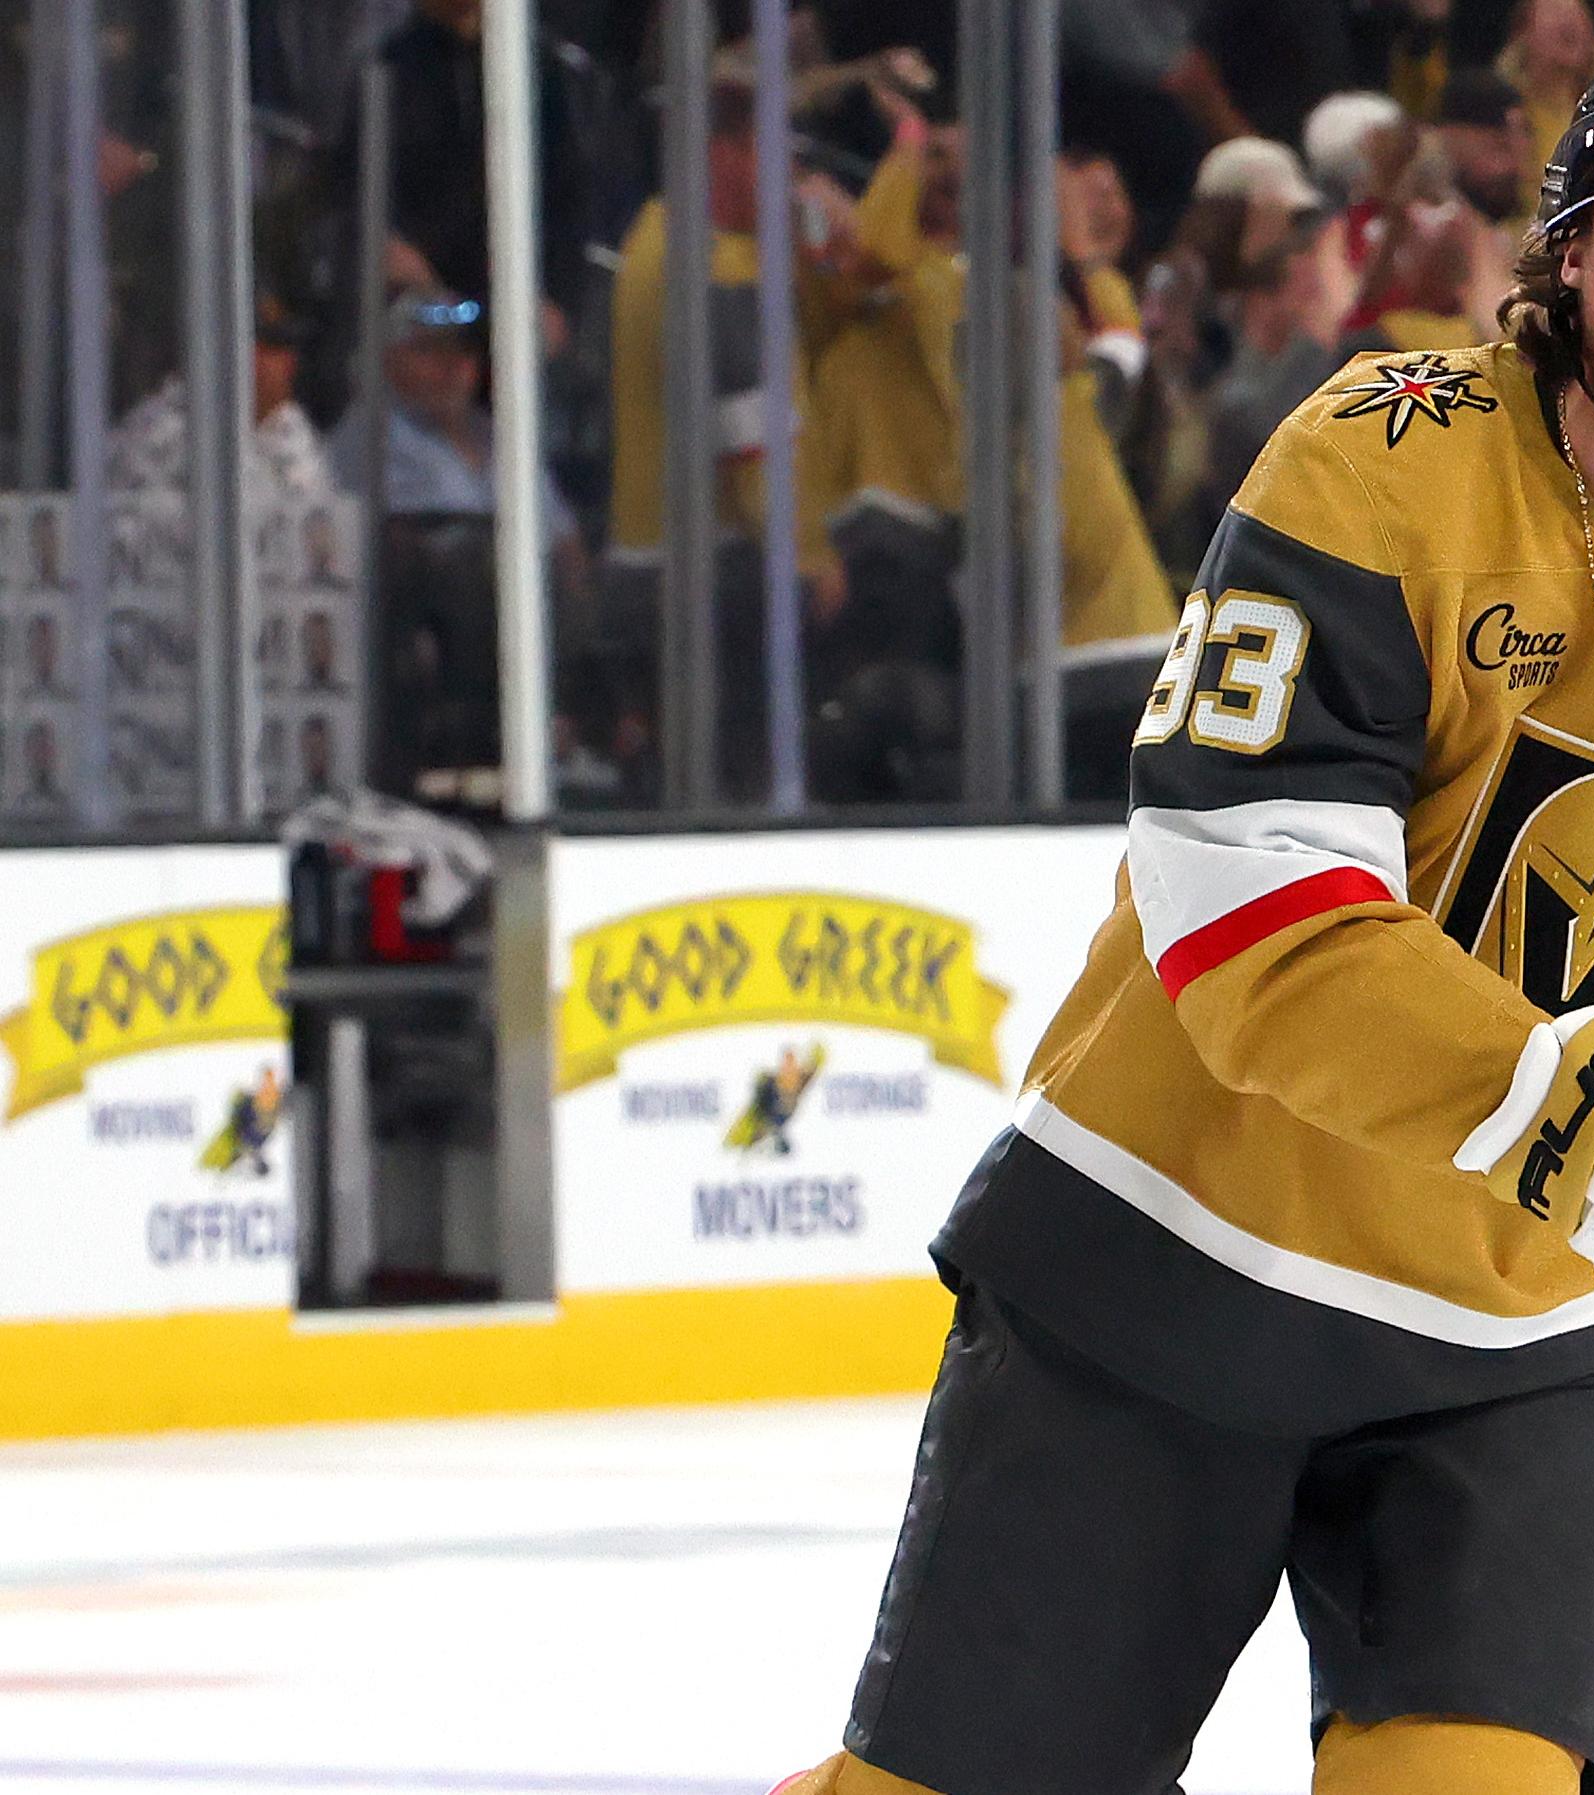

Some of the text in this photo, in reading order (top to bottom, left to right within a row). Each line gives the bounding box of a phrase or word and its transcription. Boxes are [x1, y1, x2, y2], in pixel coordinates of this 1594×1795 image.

[1466, 603, 1567, 670] Circa
[1132, 588, 1312, 756] 93
[1508, 661, 1559, 690] SPORTS
[52, 933, 230, 1044] GOOD
[586, 907, 962, 1029] GOOD GREEK
[92, 1100, 195, 1140] MOVING
[623, 1084, 721, 1122] MOVING
[694, 1175, 862, 1241] MOVERS
